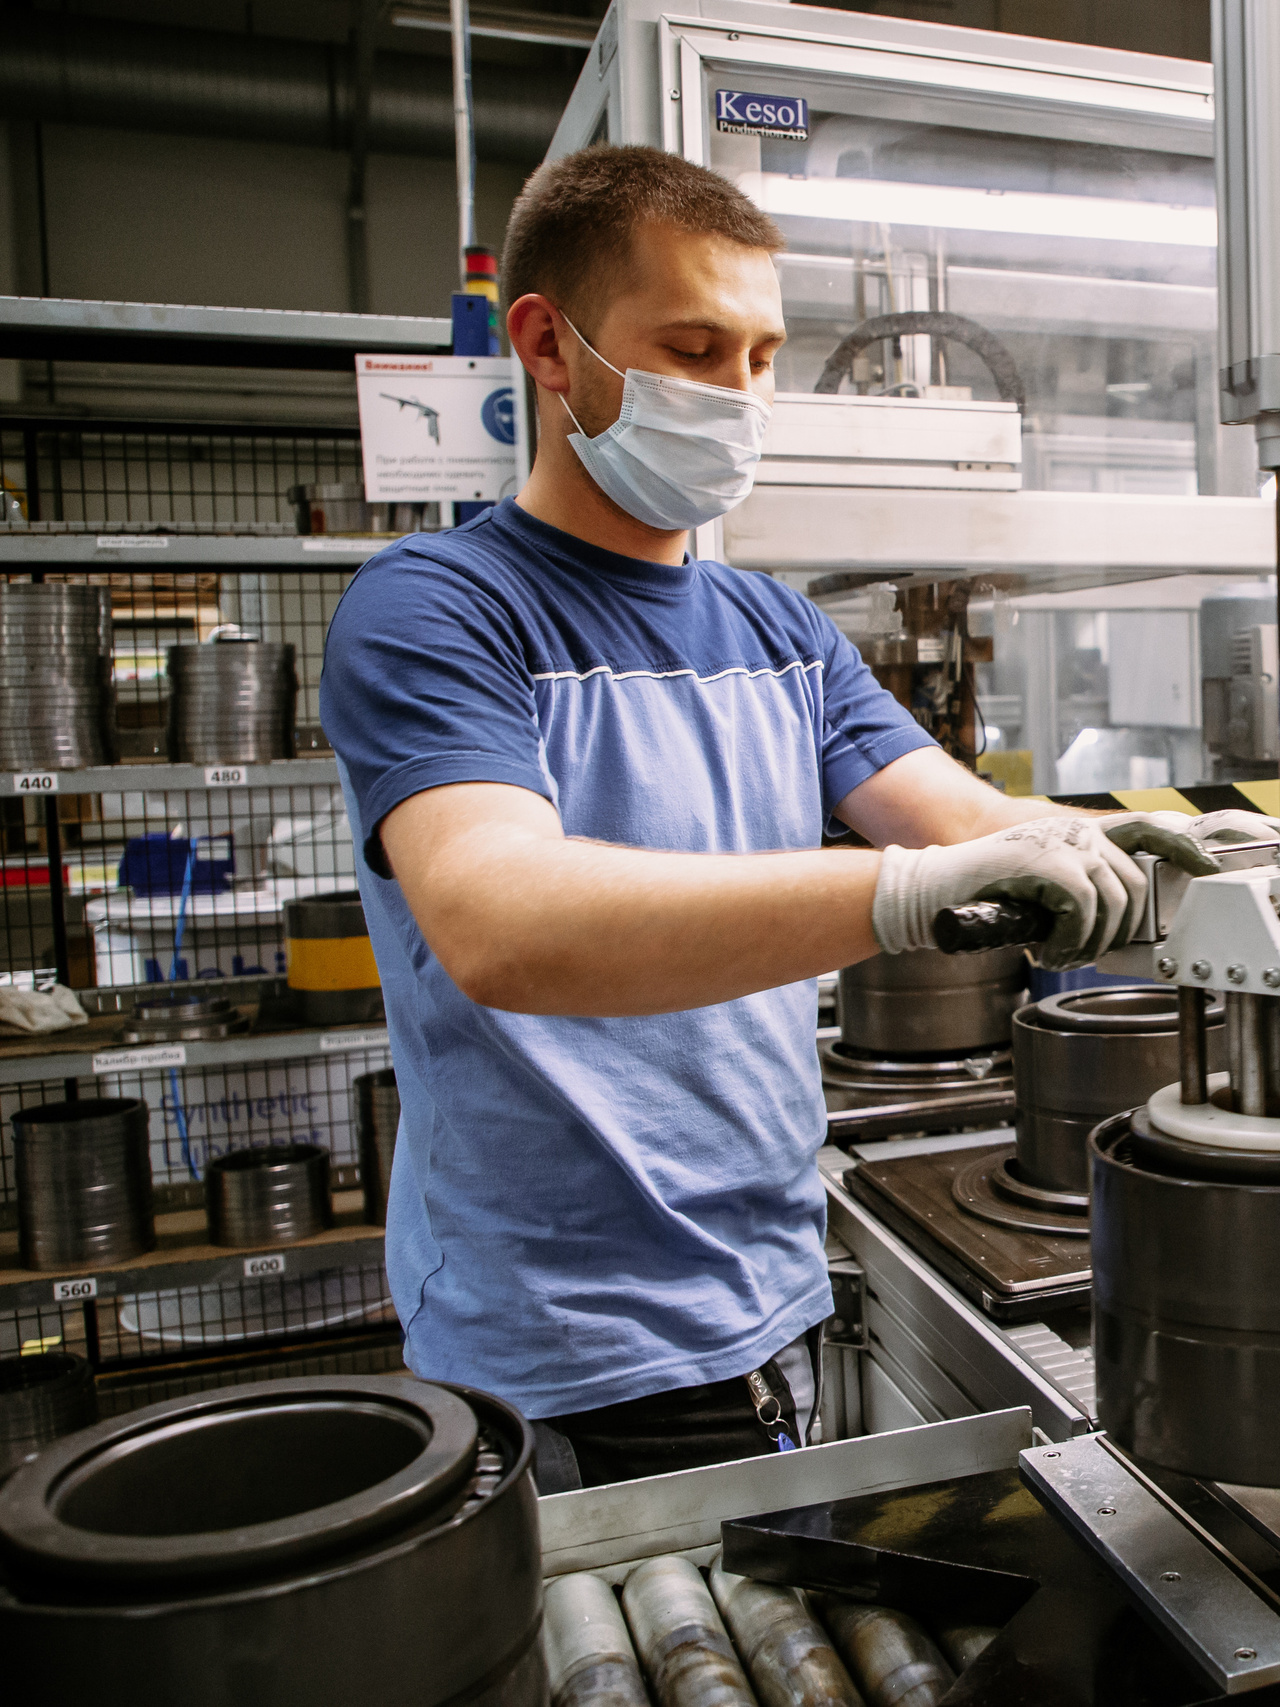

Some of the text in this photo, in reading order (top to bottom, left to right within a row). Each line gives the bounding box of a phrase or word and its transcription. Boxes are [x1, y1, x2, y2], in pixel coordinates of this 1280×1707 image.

[717, 91, 806, 127] Kesol
[719, 121, 784, 139] Production
[20, 776, 52, 790] 440
[211, 769, 241, 783] 480
[160, 1085, 319, 1127] Synthetic
[251, 1258, 279, 1274] 600
[60, 1282, 91, 1297] 560
